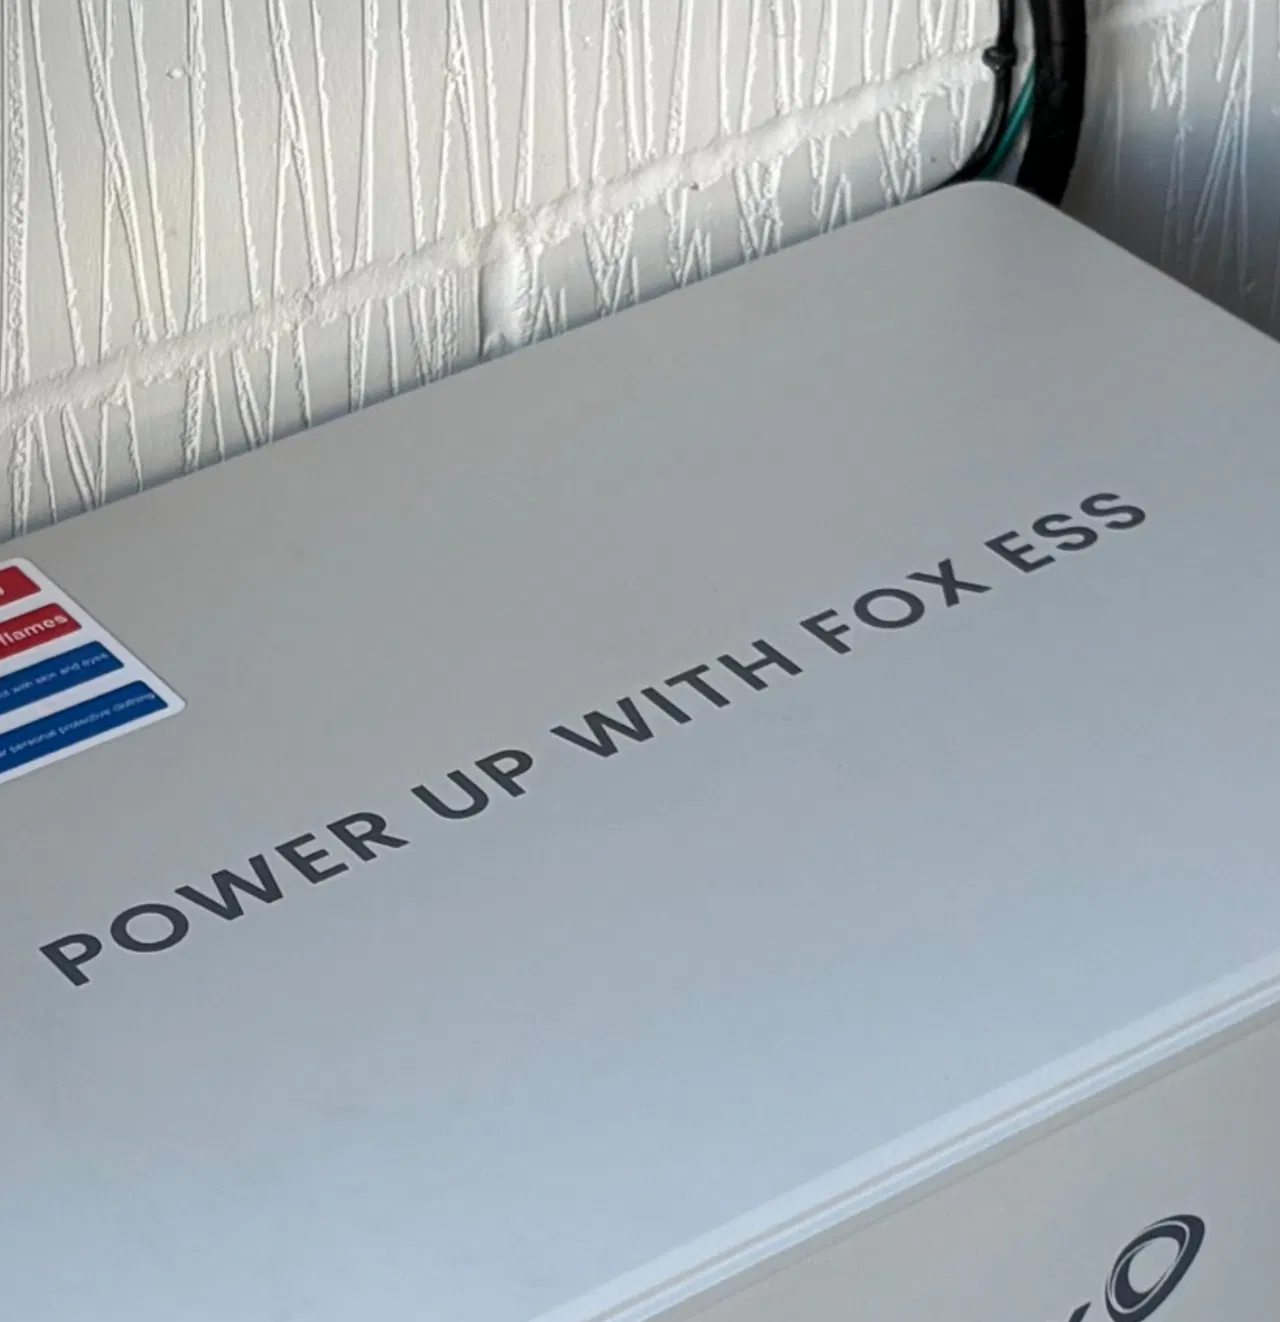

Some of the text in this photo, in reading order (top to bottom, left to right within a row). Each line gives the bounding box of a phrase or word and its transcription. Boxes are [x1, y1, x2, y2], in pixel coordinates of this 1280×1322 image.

[39, 492, 1147, 987] POWER UP WITH FOX ESS
